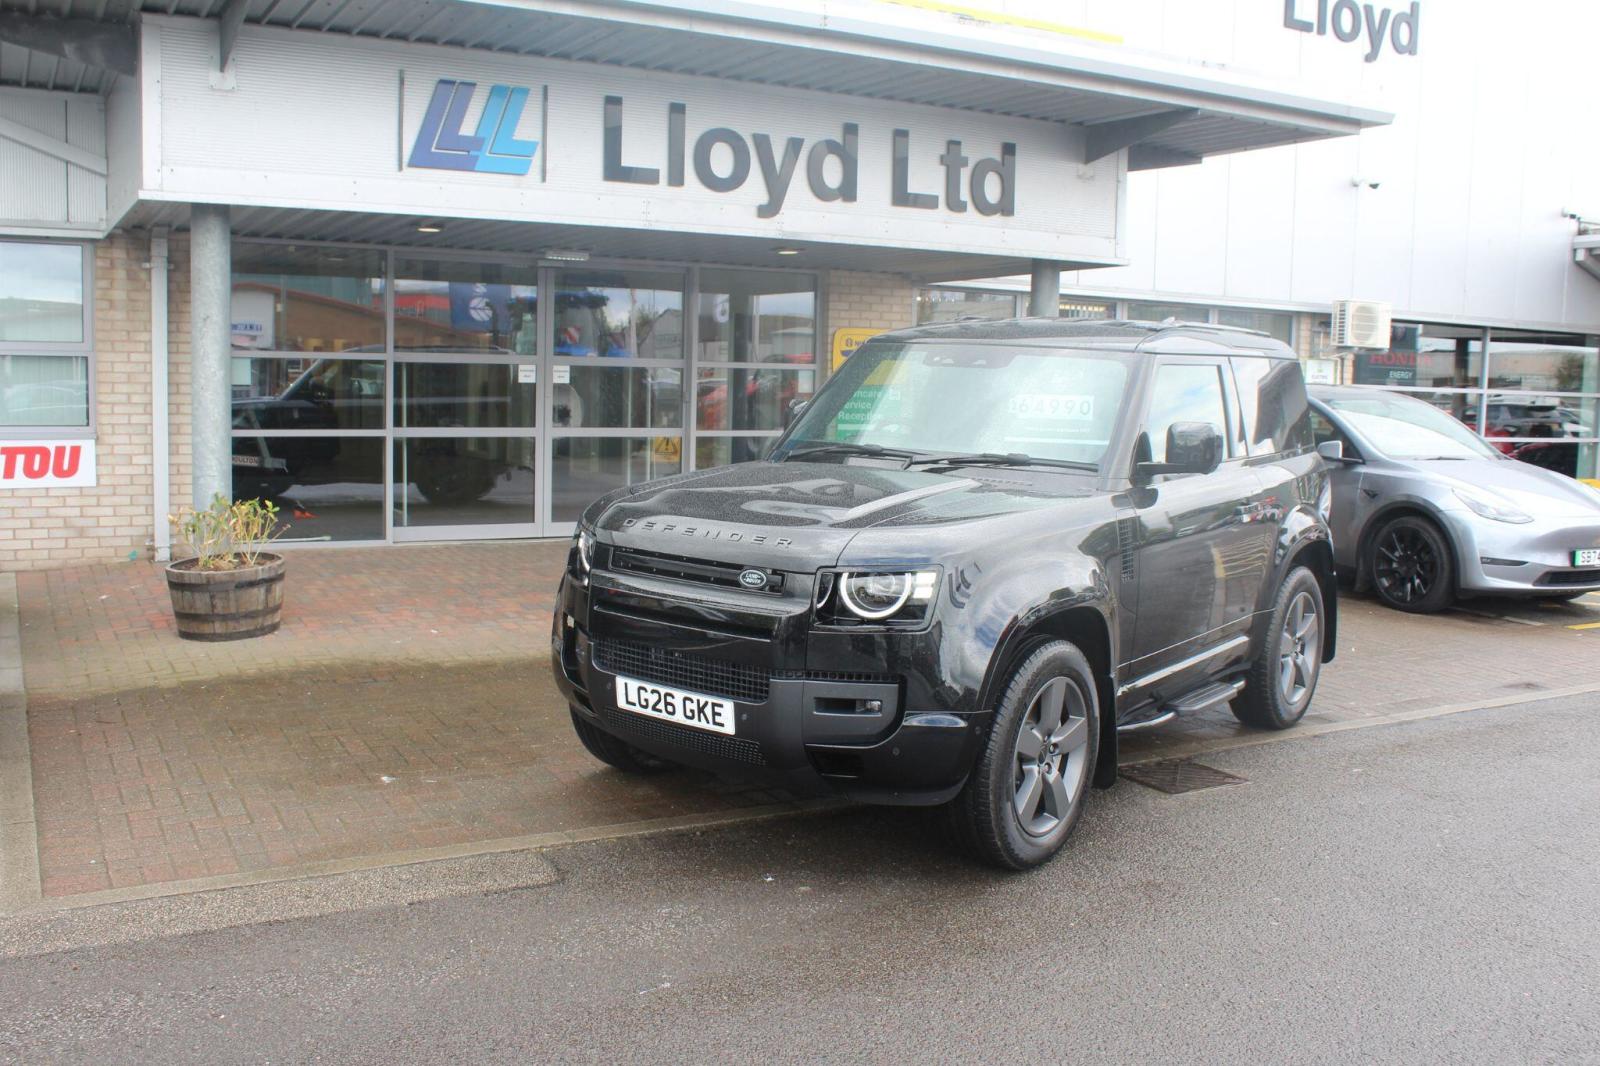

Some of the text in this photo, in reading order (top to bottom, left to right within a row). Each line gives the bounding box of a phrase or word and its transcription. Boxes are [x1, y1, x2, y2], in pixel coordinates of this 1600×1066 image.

[1284, 0, 1420, 63] Lloyd
[603, 95, 1017, 219] Lloyd Ltd
[0, 445, 82, 480] TOU
[622, 518, 793, 548] DEFENDER
[624, 682, 725, 728] LG26 GKE
